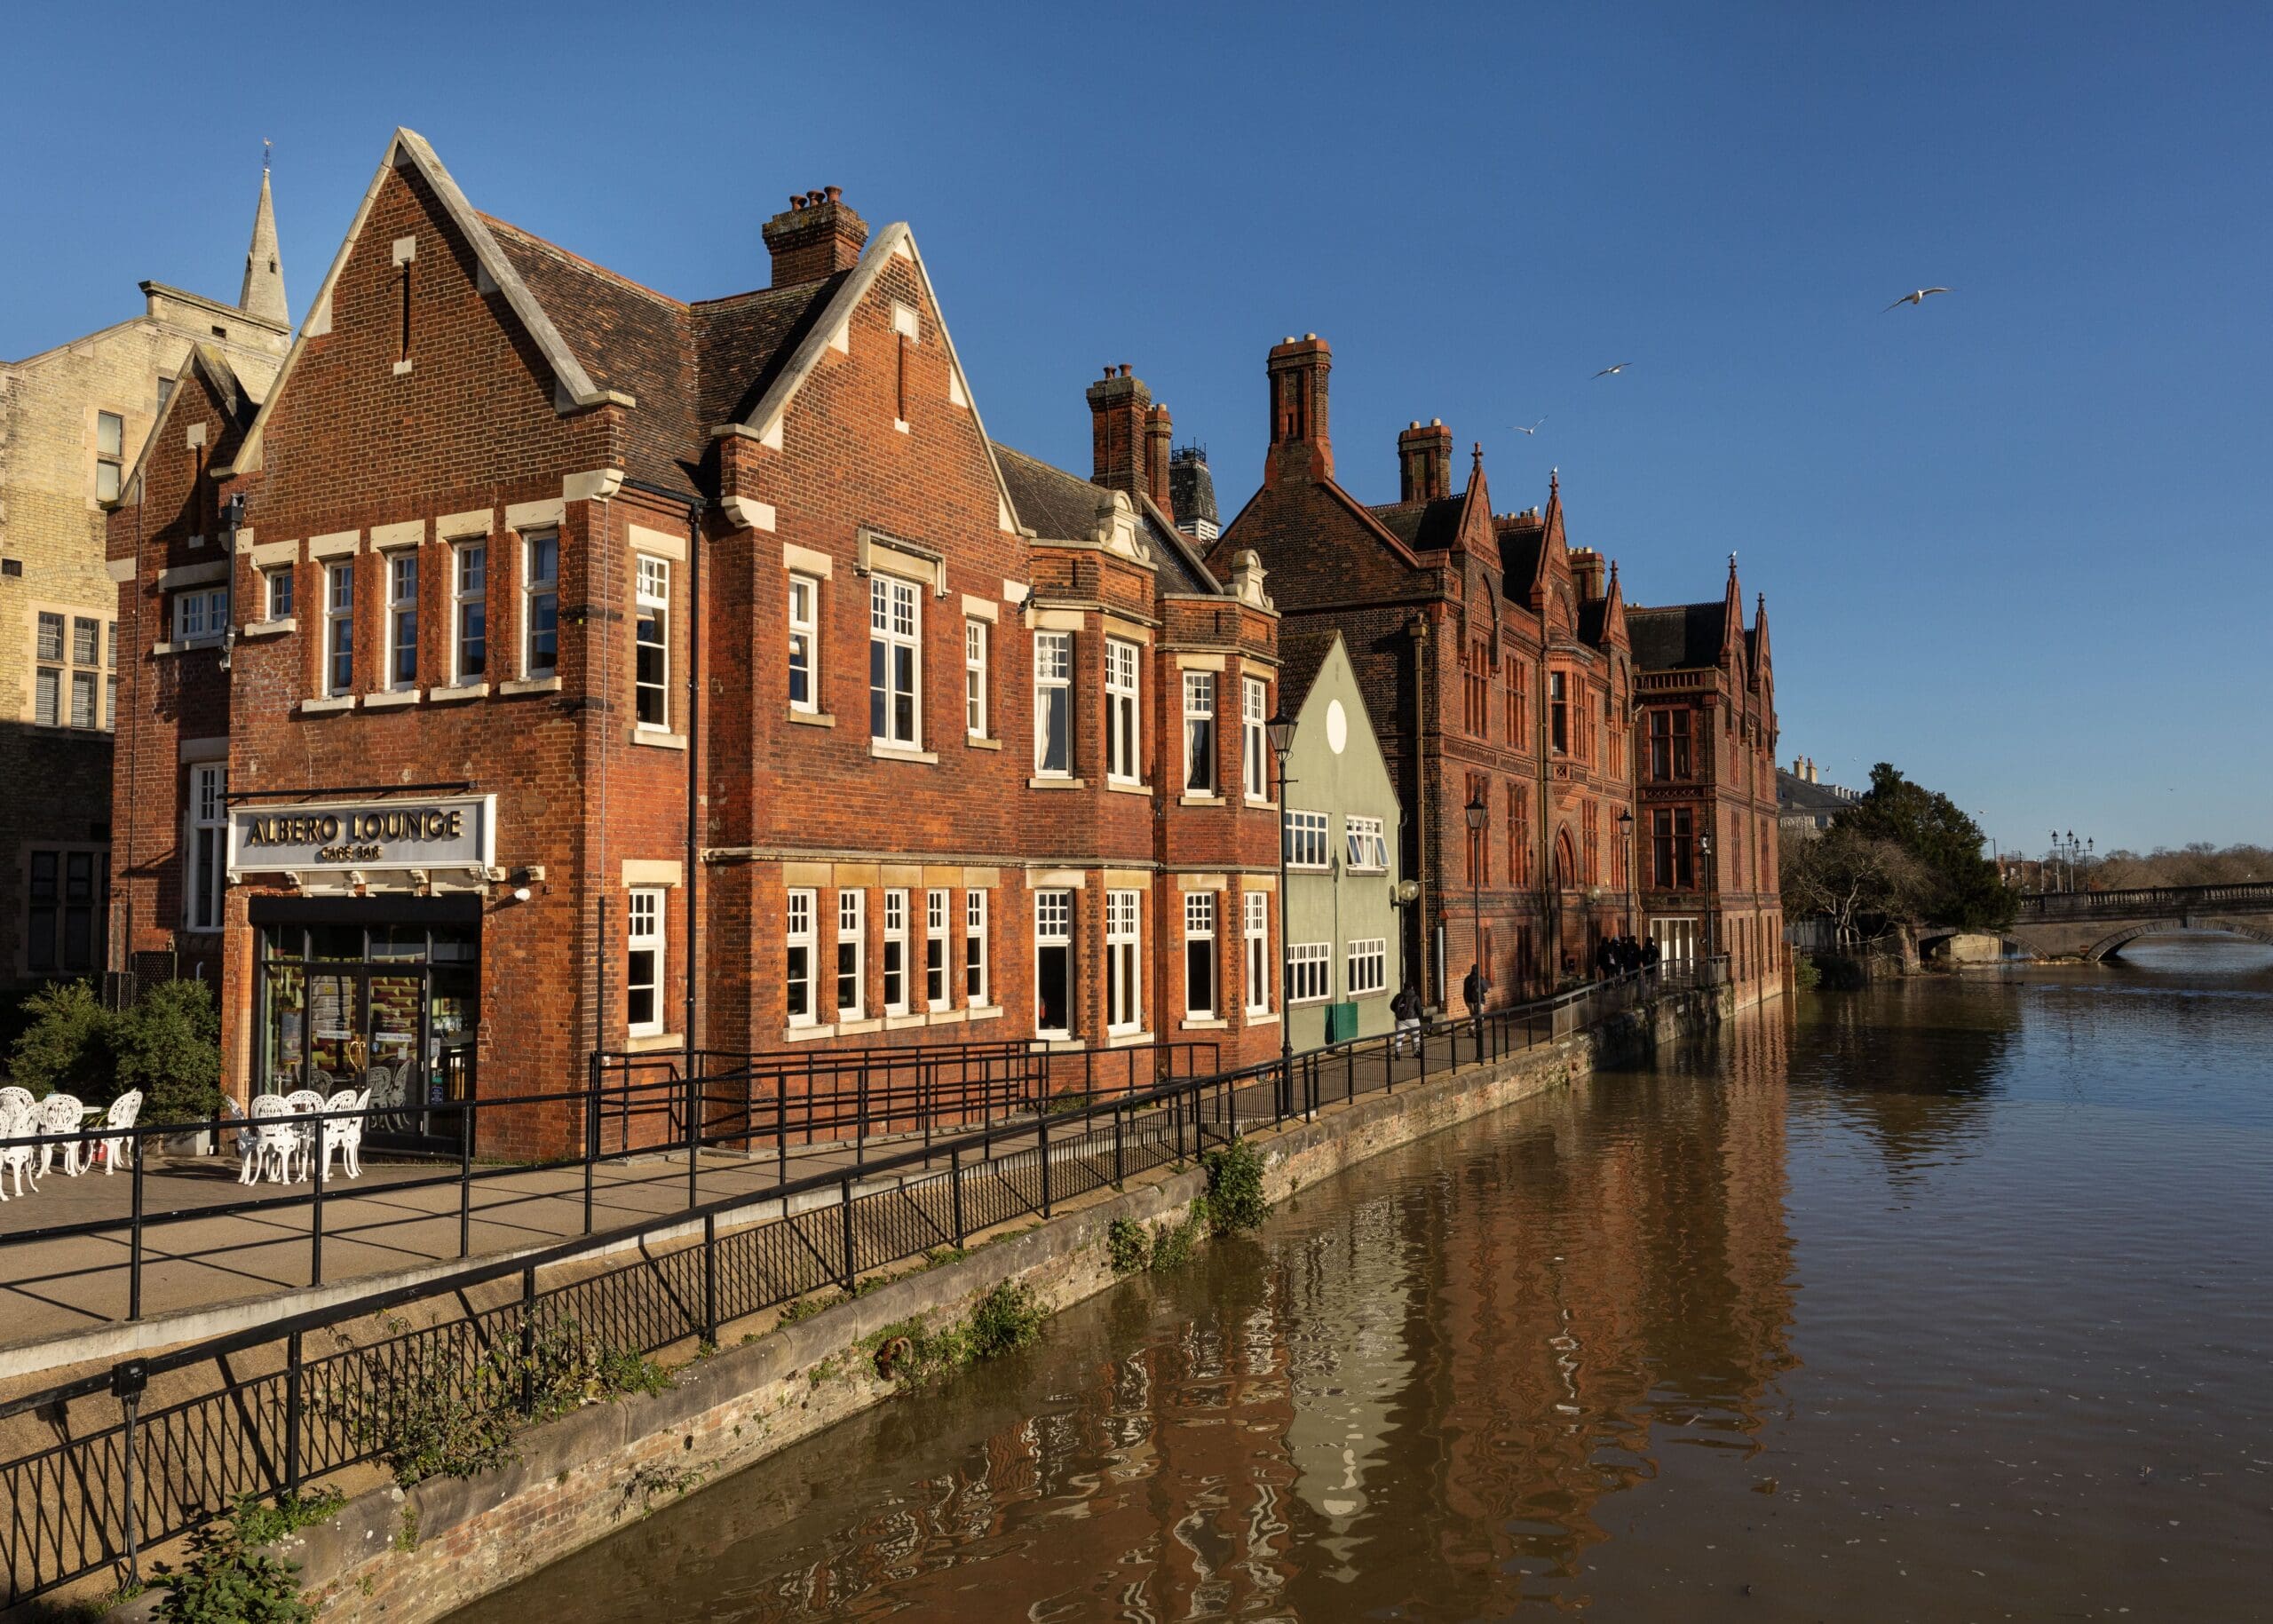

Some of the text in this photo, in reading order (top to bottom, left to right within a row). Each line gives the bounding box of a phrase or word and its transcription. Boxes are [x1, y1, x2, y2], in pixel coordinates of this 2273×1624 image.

[249, 810, 464, 844] ALBERO LOUNGE
[357, 845, 382, 859] BAR
